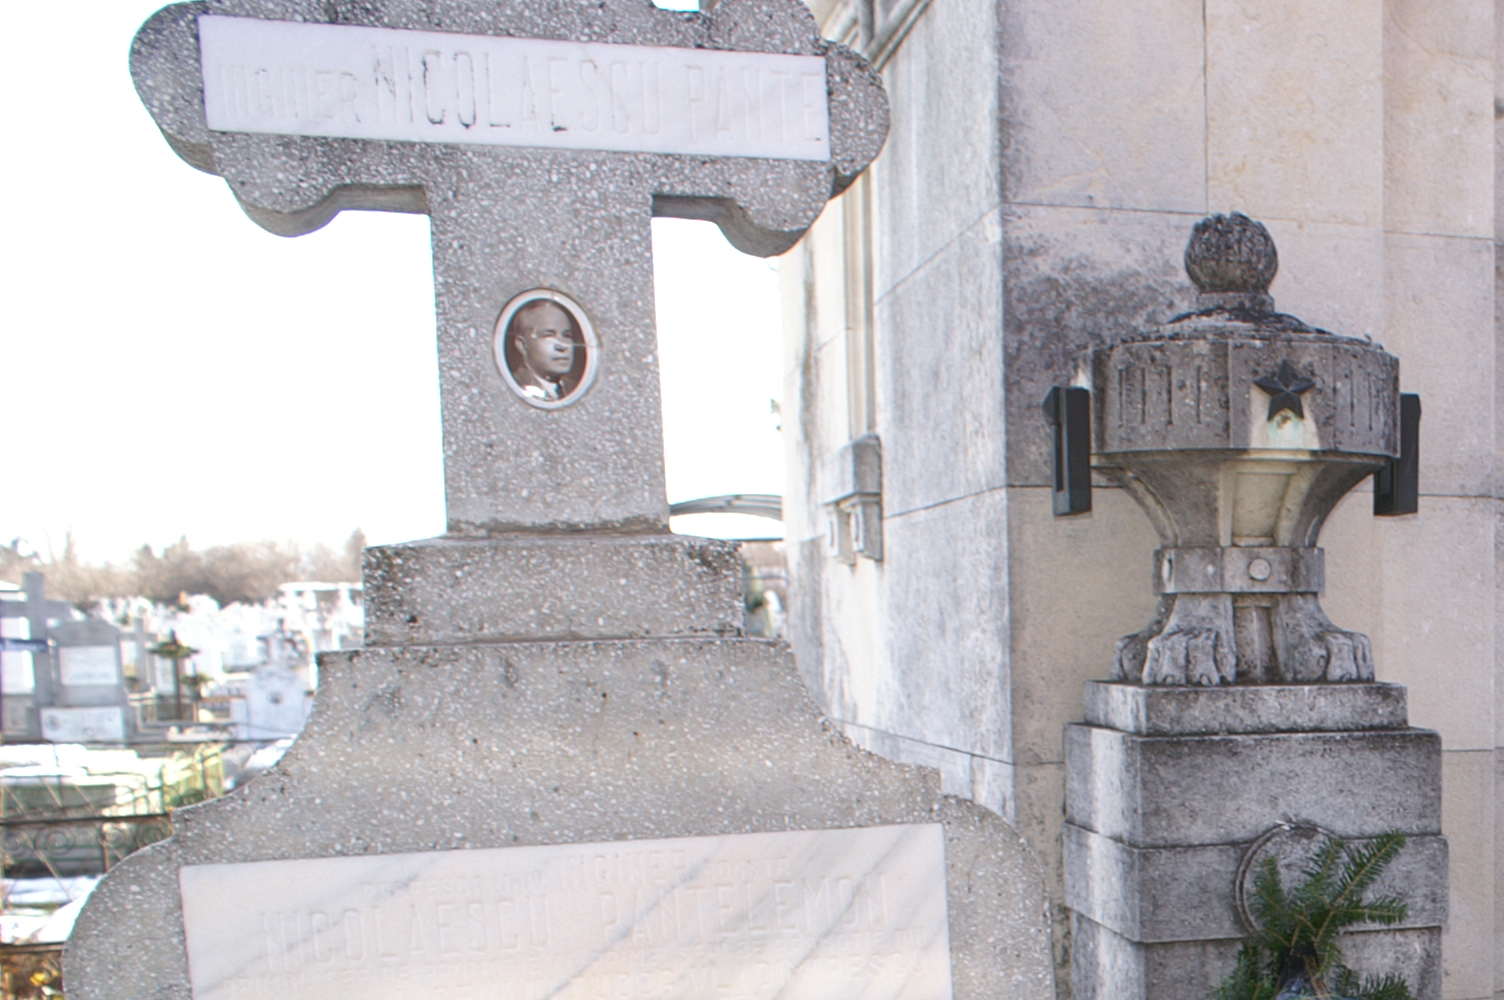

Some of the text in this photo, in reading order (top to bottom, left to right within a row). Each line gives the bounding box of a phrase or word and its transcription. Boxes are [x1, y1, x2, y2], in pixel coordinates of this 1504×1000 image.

[371, 44, 662, 136] NICOLAESCU
[262, 873, 889, 970] NICOLAESCU PANTELEMON
